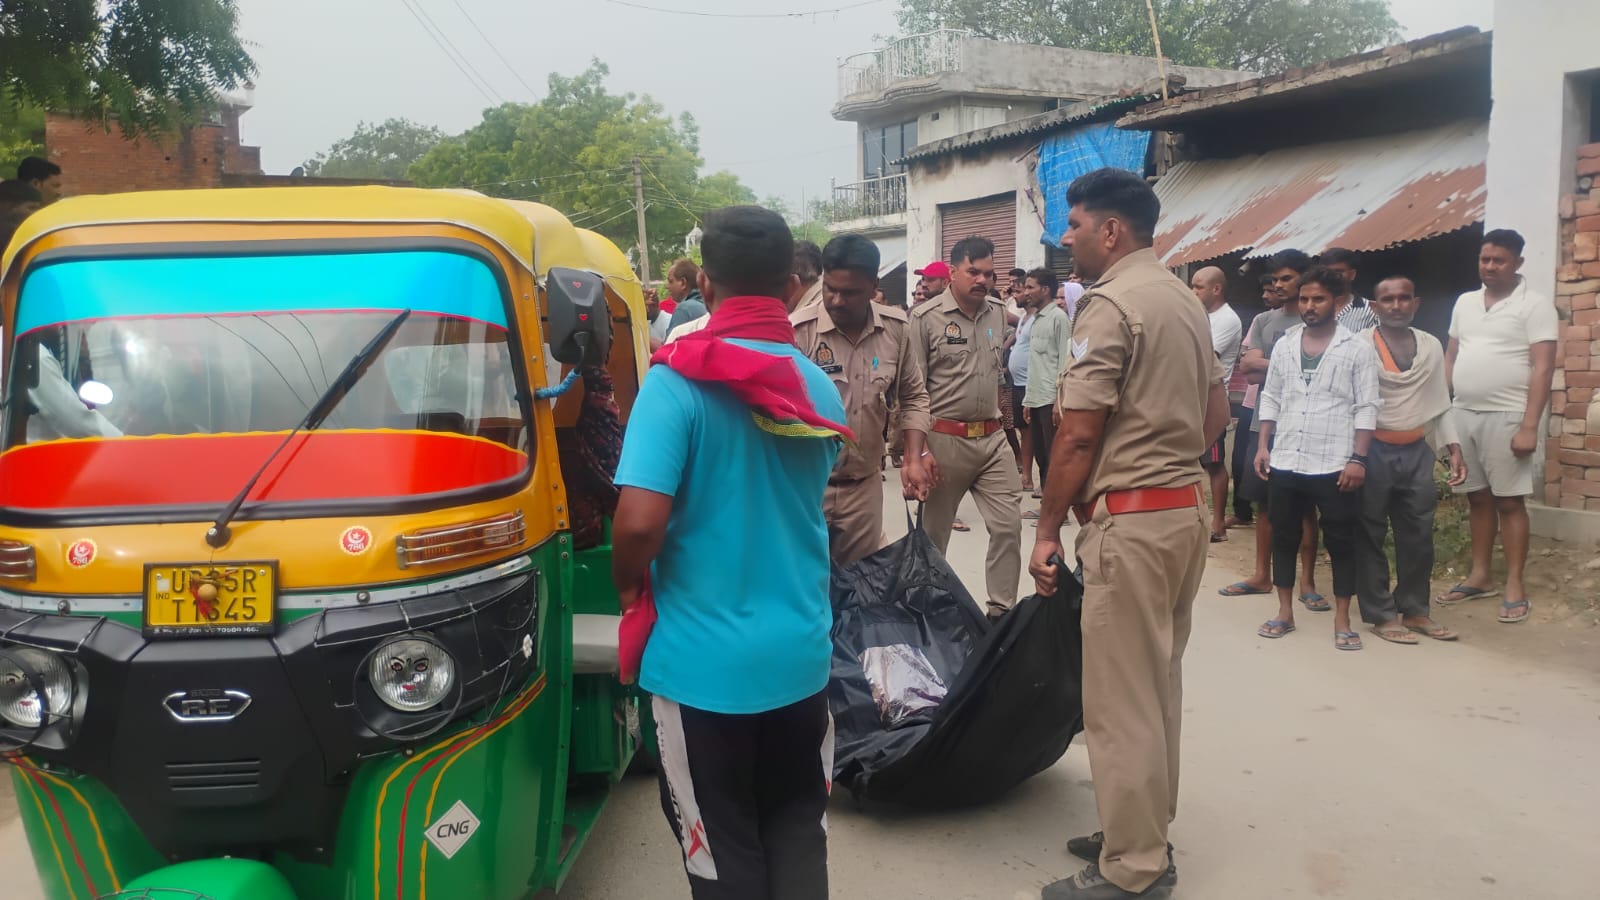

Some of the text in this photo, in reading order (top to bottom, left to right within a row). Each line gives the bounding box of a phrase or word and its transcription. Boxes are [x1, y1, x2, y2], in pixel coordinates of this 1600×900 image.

[155, 592, 170, 600] IND
[182, 699, 231, 716] RE
[437, 819, 470, 838] CNG
